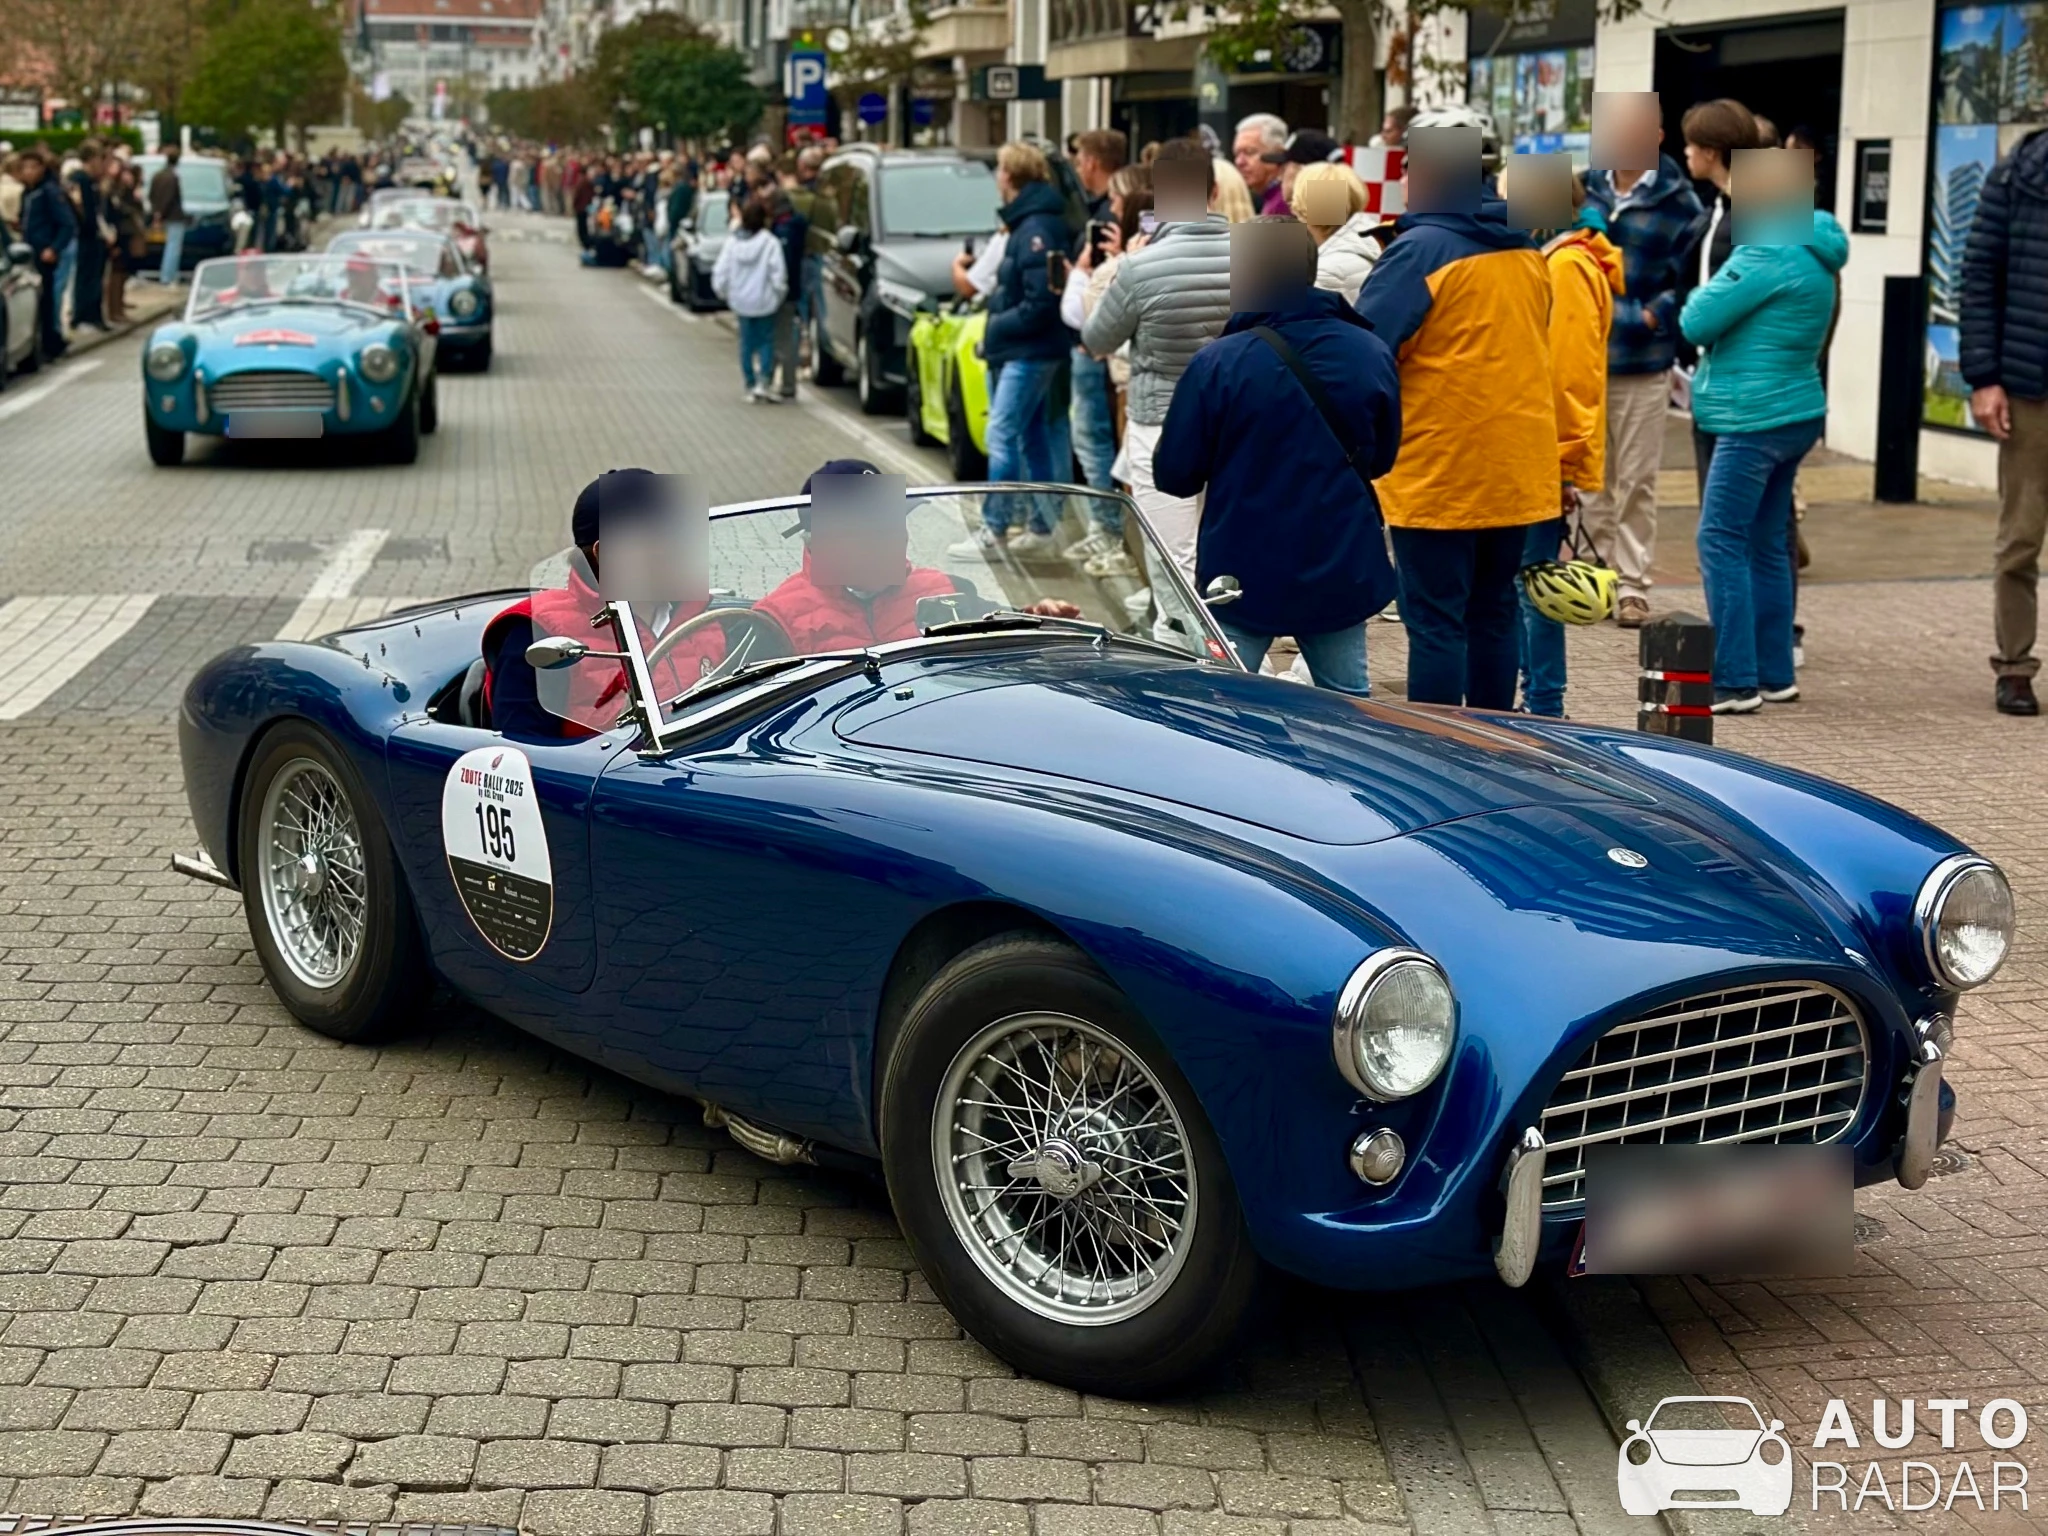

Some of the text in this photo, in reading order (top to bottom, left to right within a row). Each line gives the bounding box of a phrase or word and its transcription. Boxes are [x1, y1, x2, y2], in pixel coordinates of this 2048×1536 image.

[461, 767, 524, 797] ZOUTE RALLY 2025
[475, 802, 516, 862] 195
